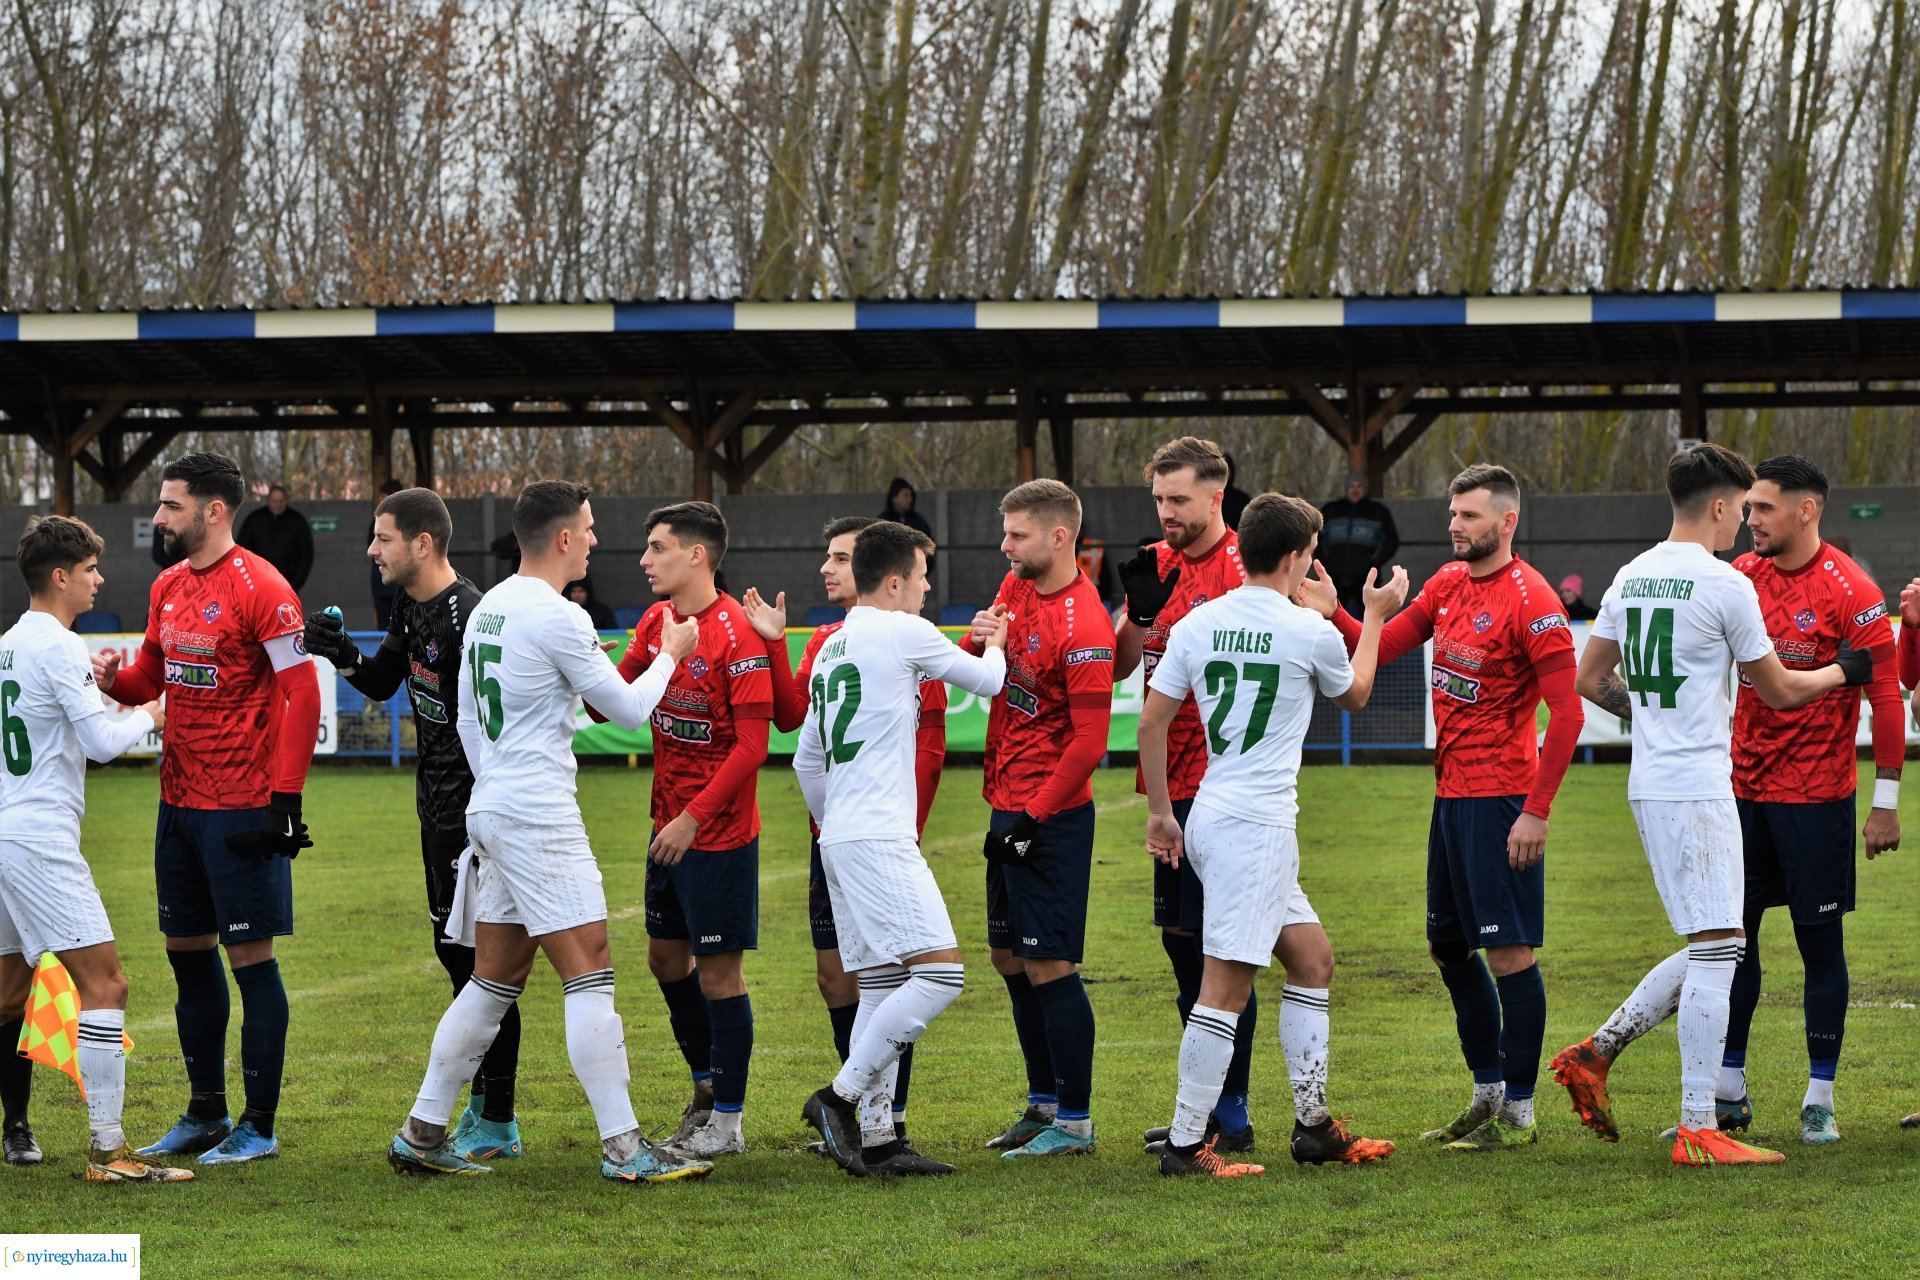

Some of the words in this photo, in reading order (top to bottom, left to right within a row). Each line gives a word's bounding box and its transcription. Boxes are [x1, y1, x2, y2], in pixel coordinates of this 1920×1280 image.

[1213, 628, 1273, 655] VITÁLIS
[1624, 607, 1689, 708] 44
[166, 664, 214, 684] PPMIX
[468, 641, 504, 742] 15
[665, 685, 709, 704] EVESZ
[1204, 660, 1280, 755] 27
[1, 679, 33, 777] 6
[1819, 902, 1838, 912] JAKO
[229, 922, 250, 932] JAKO
[700, 935, 722, 943] JAKO
[1808, 1031, 1836, 1040] JAKO
